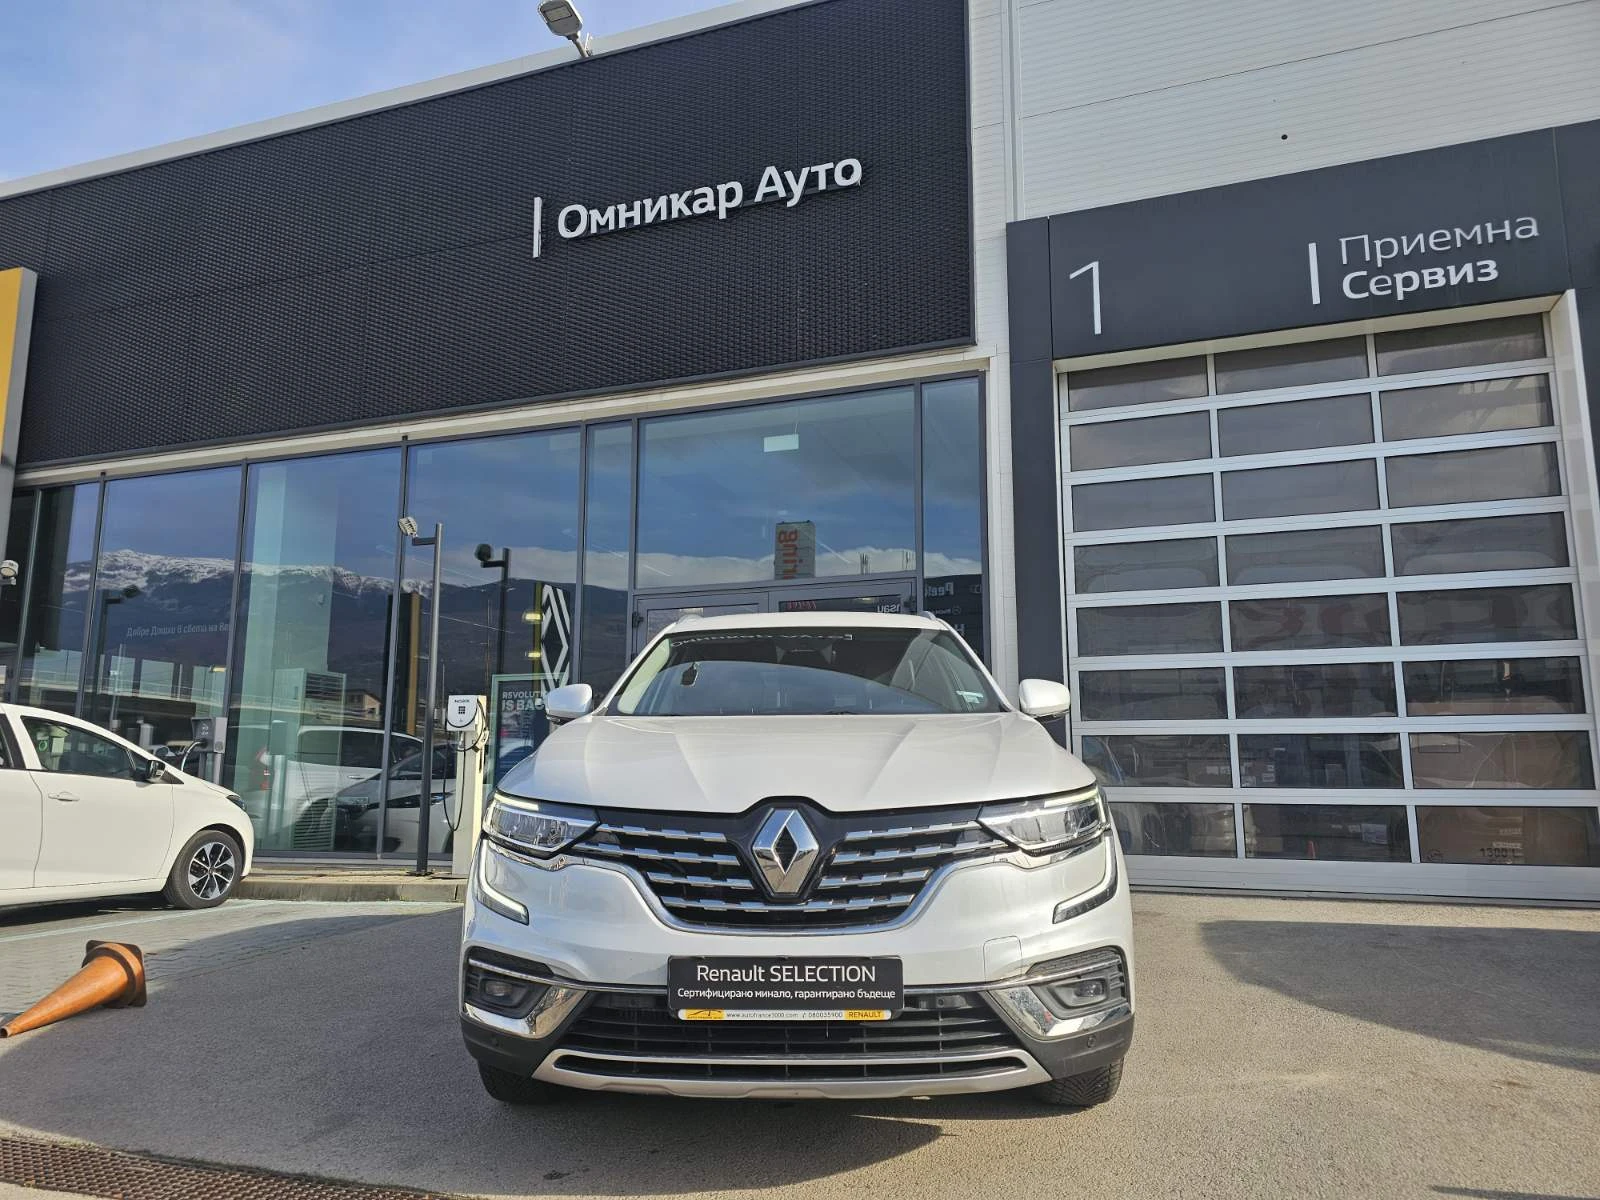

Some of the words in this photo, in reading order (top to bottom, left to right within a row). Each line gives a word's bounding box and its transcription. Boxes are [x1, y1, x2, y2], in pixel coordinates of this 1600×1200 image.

[557, 180, 743, 239] Омникар
[754, 157, 863, 207] Ауто
[1338, 216, 1540, 267] Приемна
[1069, 261, 1102, 335] 1
[1342, 258, 1499, 301] Сервиз
[502, 700, 514, 711] IS
[677, 988, 753, 999] Сертифицирано
[755, 989, 793, 1000] минало,
[795, 989, 855, 999] гарантирано
[857, 987, 896, 1000] бъдеще
[697, 965, 765, 982] Renault
[770, 965, 876, 982] SELECTION
